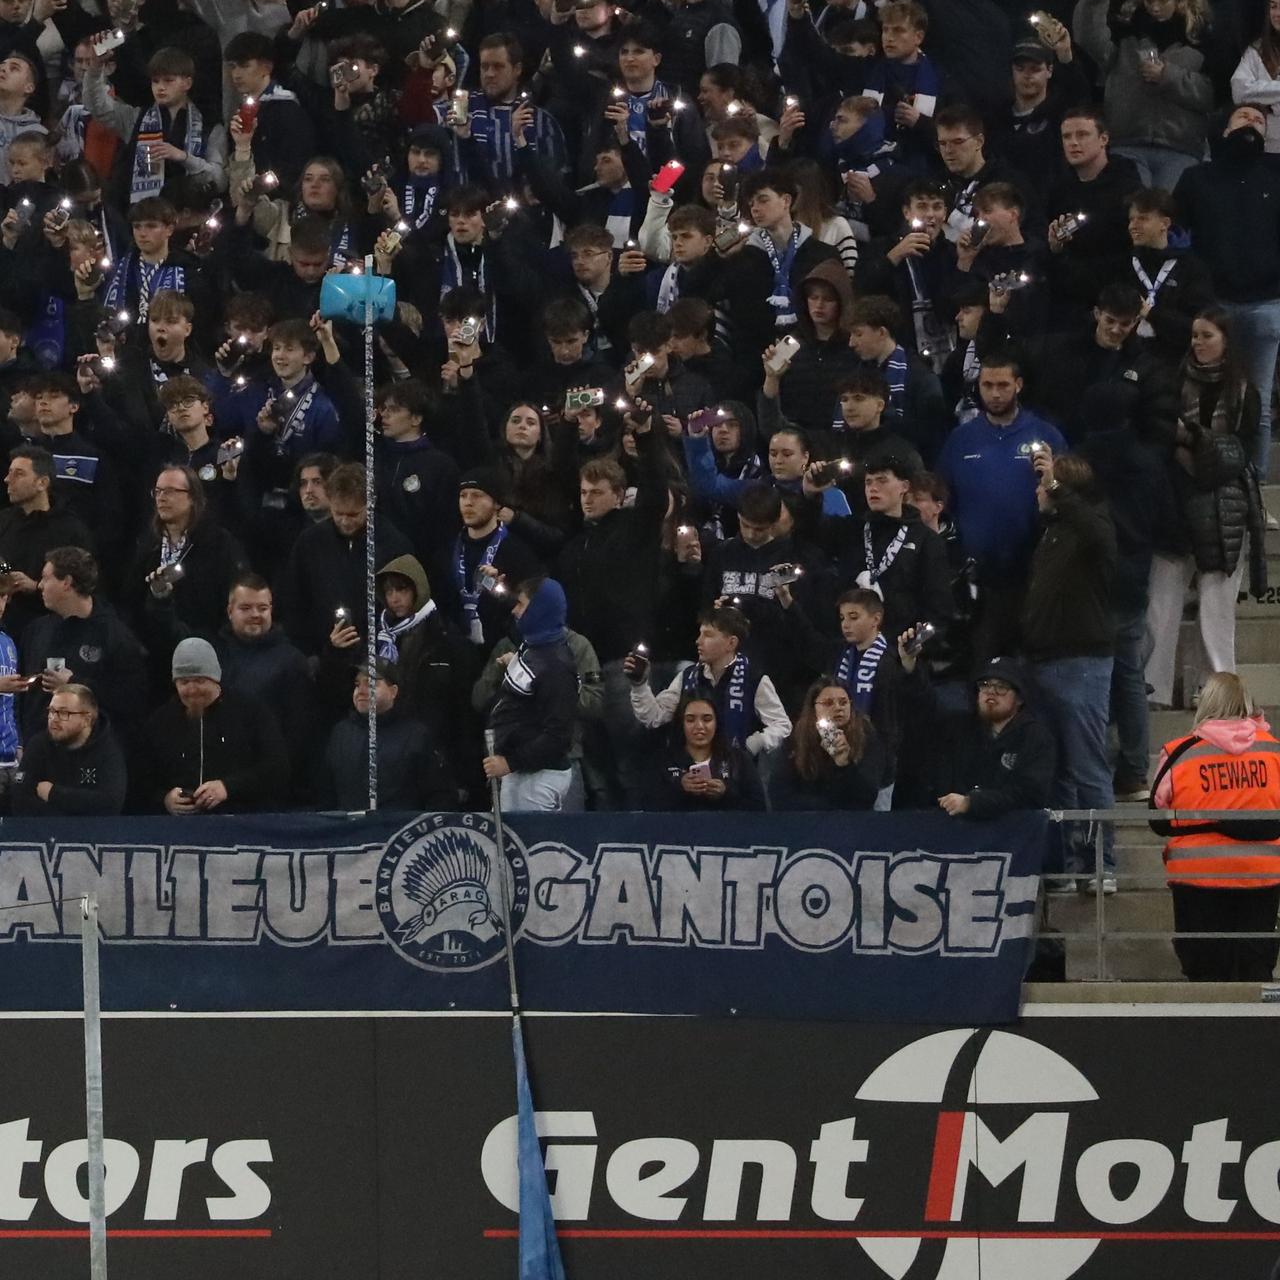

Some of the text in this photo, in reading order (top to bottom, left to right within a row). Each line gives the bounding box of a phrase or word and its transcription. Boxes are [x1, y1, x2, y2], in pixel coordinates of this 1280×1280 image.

[1200, 760, 1268, 793] STEWARD
[380, 814, 527, 913] BANLIEUE GATOISE
[520, 847, 1011, 957] GANTOISE
[481, 1111, 870, 1225] Gent
